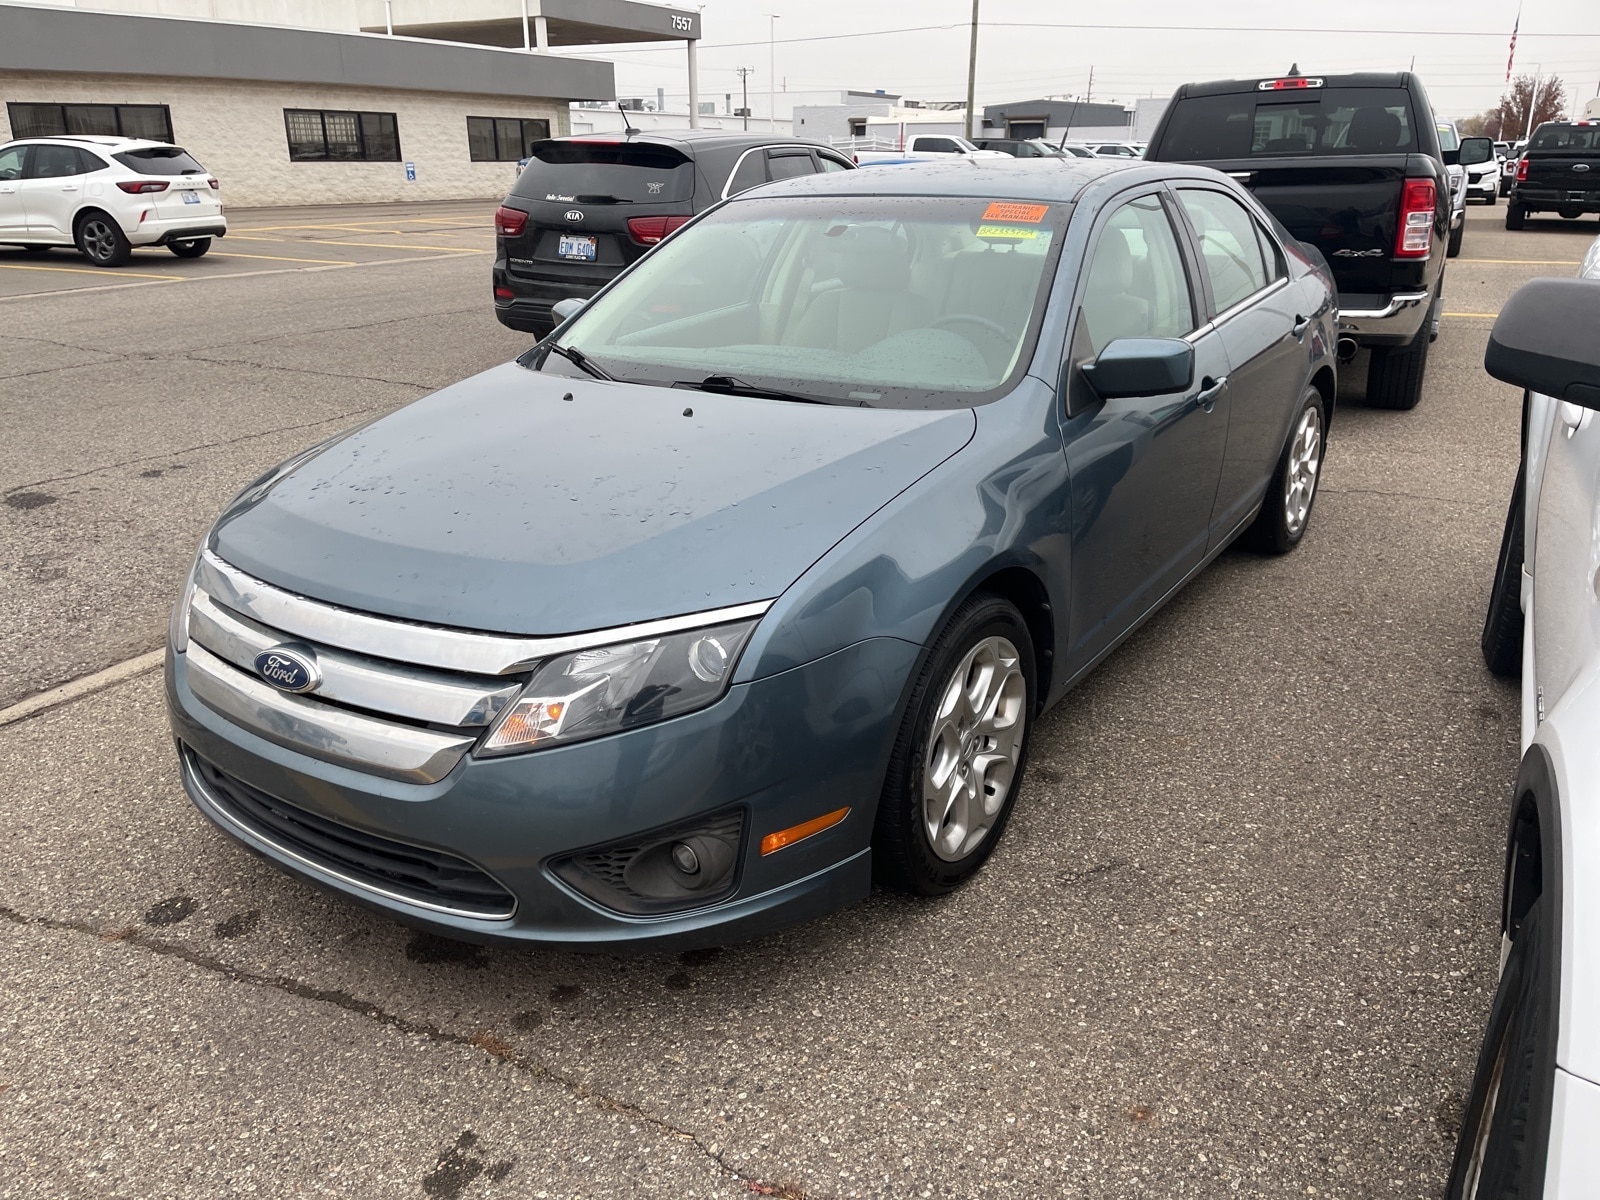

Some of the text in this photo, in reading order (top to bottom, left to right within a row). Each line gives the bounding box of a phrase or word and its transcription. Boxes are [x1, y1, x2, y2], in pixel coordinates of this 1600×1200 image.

[671, 15, 692, 31] 7557
[566, 212, 580, 220] KIA
[577, 242, 595, 256] 6406
[263, 655, 299, 684] Ford
